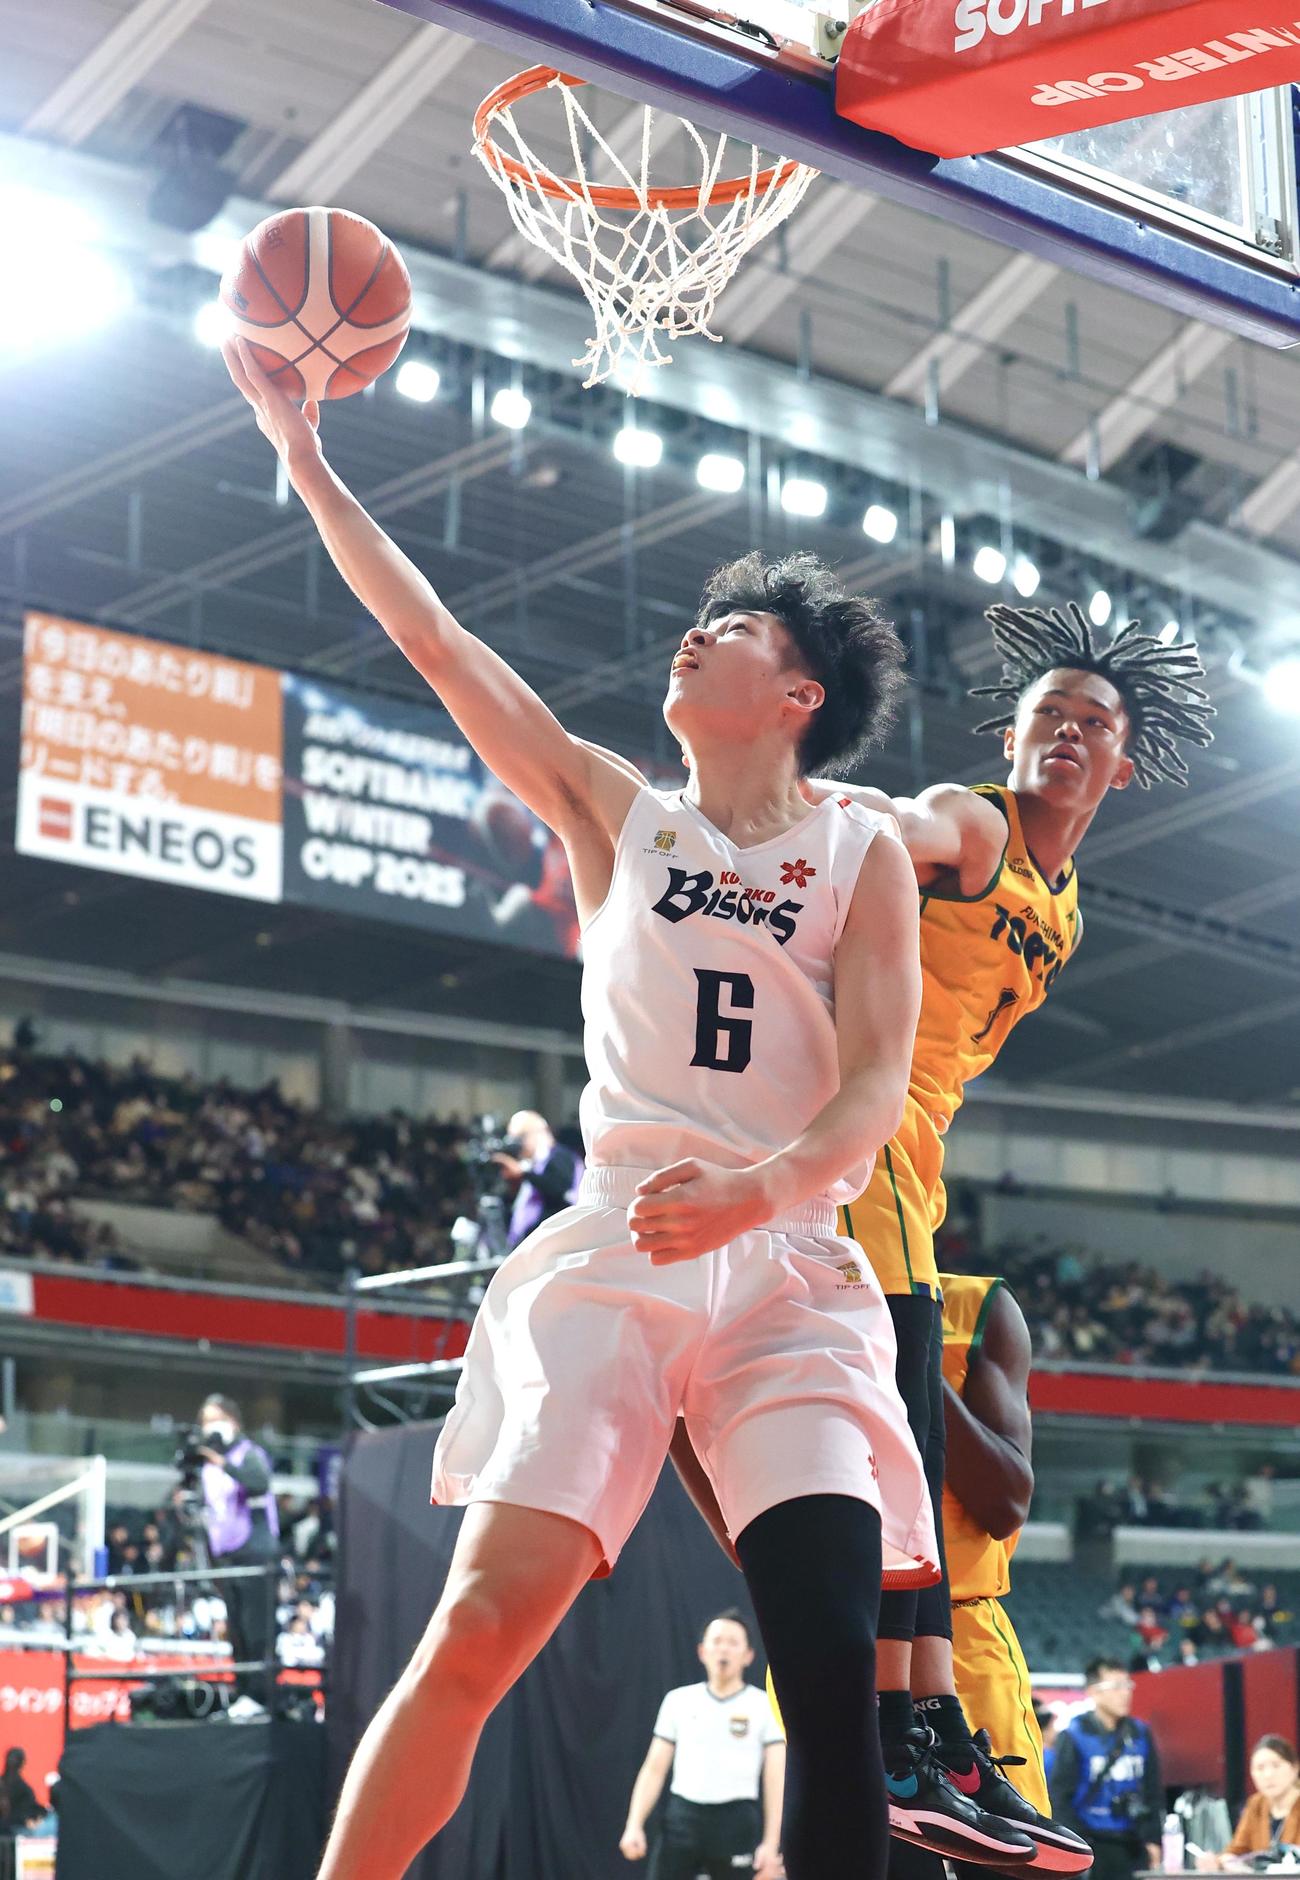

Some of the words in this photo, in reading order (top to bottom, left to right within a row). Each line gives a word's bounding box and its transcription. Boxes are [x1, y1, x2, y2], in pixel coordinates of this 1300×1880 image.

[955, 0, 1108, 53] SOF
[1133, 21, 1300, 81] INTER
[1031, 72, 1144, 106] CUP
[302, 747, 472, 818] SOFTBANK
[84, 806, 257, 880] ENEOS
[303, 793, 432, 854] WINTER
[302, 840, 372, 886] CUP
[689, 968, 754, 1073] 6
[970, 987, 1019, 1044] 1
